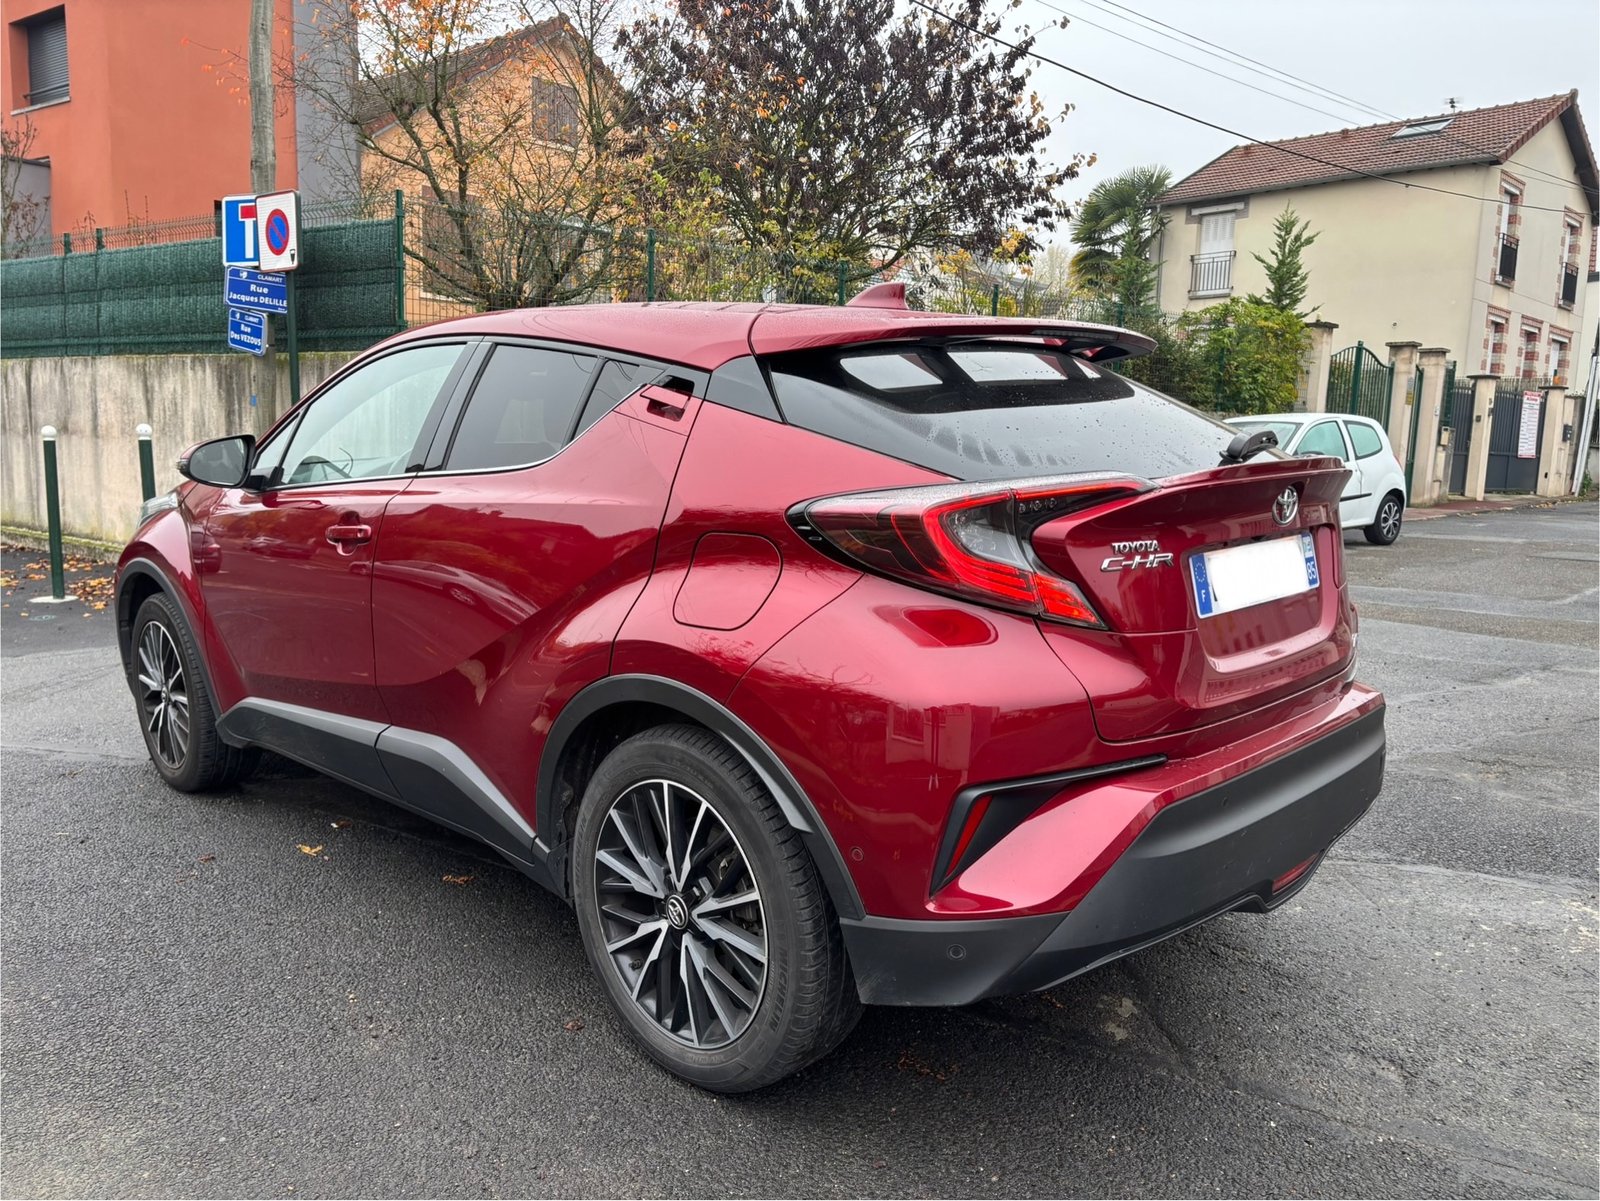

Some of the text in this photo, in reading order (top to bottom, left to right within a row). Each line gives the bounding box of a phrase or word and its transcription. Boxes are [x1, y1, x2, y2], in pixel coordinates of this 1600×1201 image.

[257, 274, 283, 283] CLAMART
[250, 284, 269, 294] Rue
[229, 291, 288, 307] Jacques DELILLE
[240, 323, 251, 333] Rue
[1111, 540, 1160, 554] TOYOTA
[1101, 553, 1174, 571] C-HR
[1201, 589, 1206, 602] F
